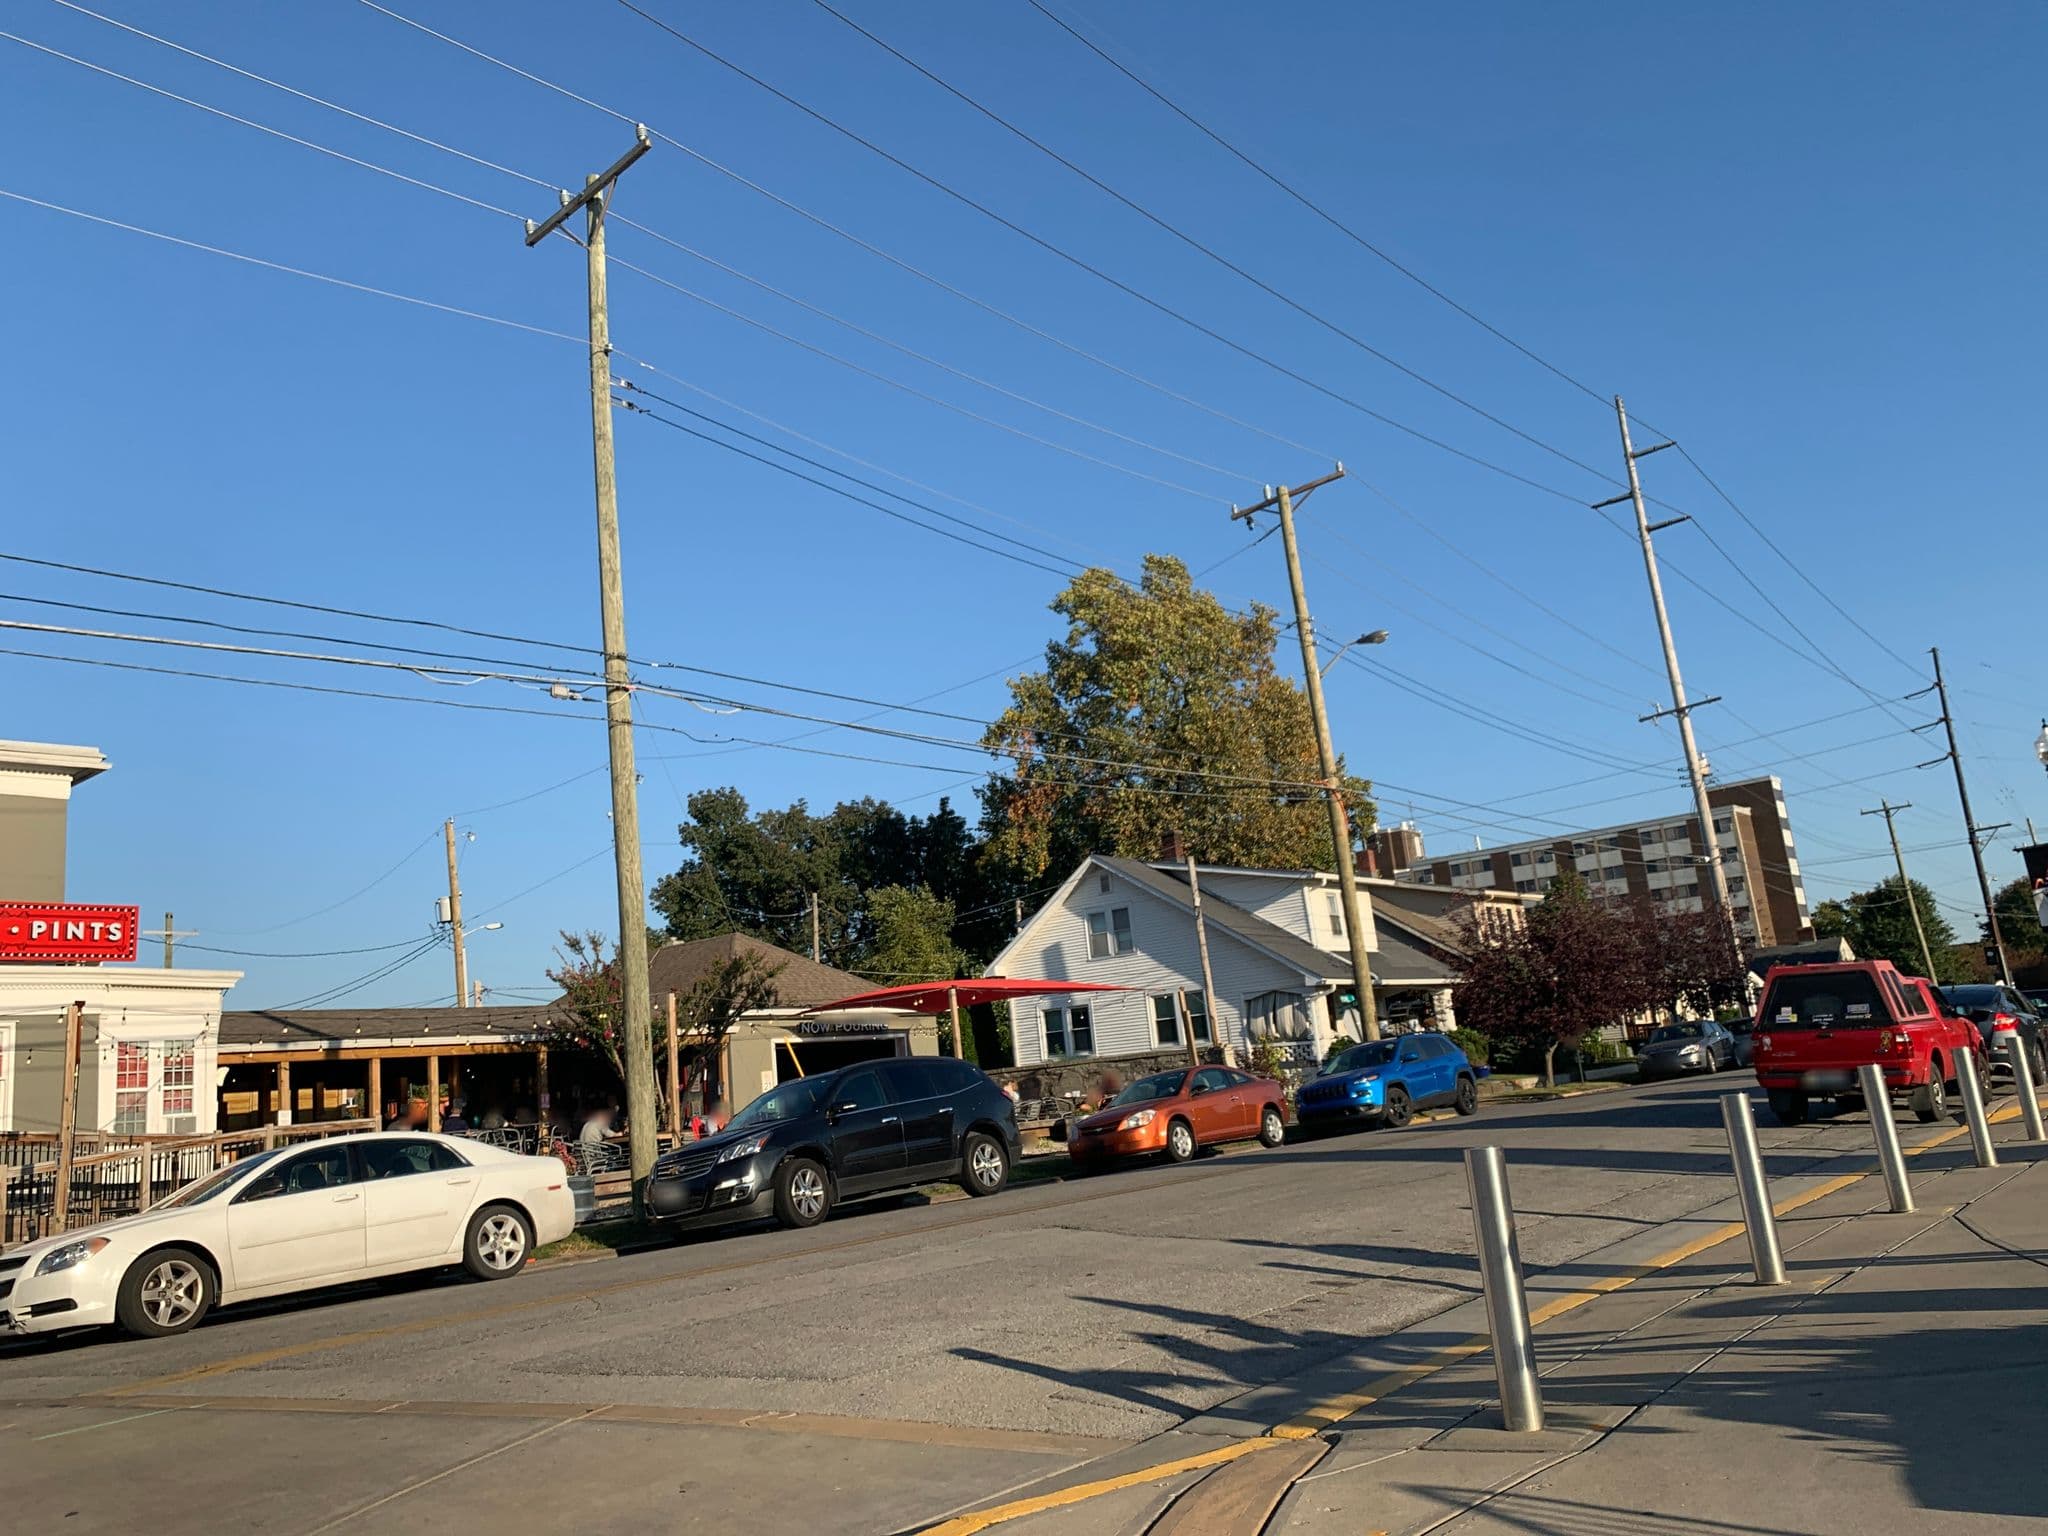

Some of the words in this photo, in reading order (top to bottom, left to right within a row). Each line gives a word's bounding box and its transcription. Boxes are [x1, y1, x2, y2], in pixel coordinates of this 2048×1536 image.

[31, 920, 122, 941] PINTS
[801, 1022, 830, 1033] NOW
[835, 1022, 889, 1032] POURING
